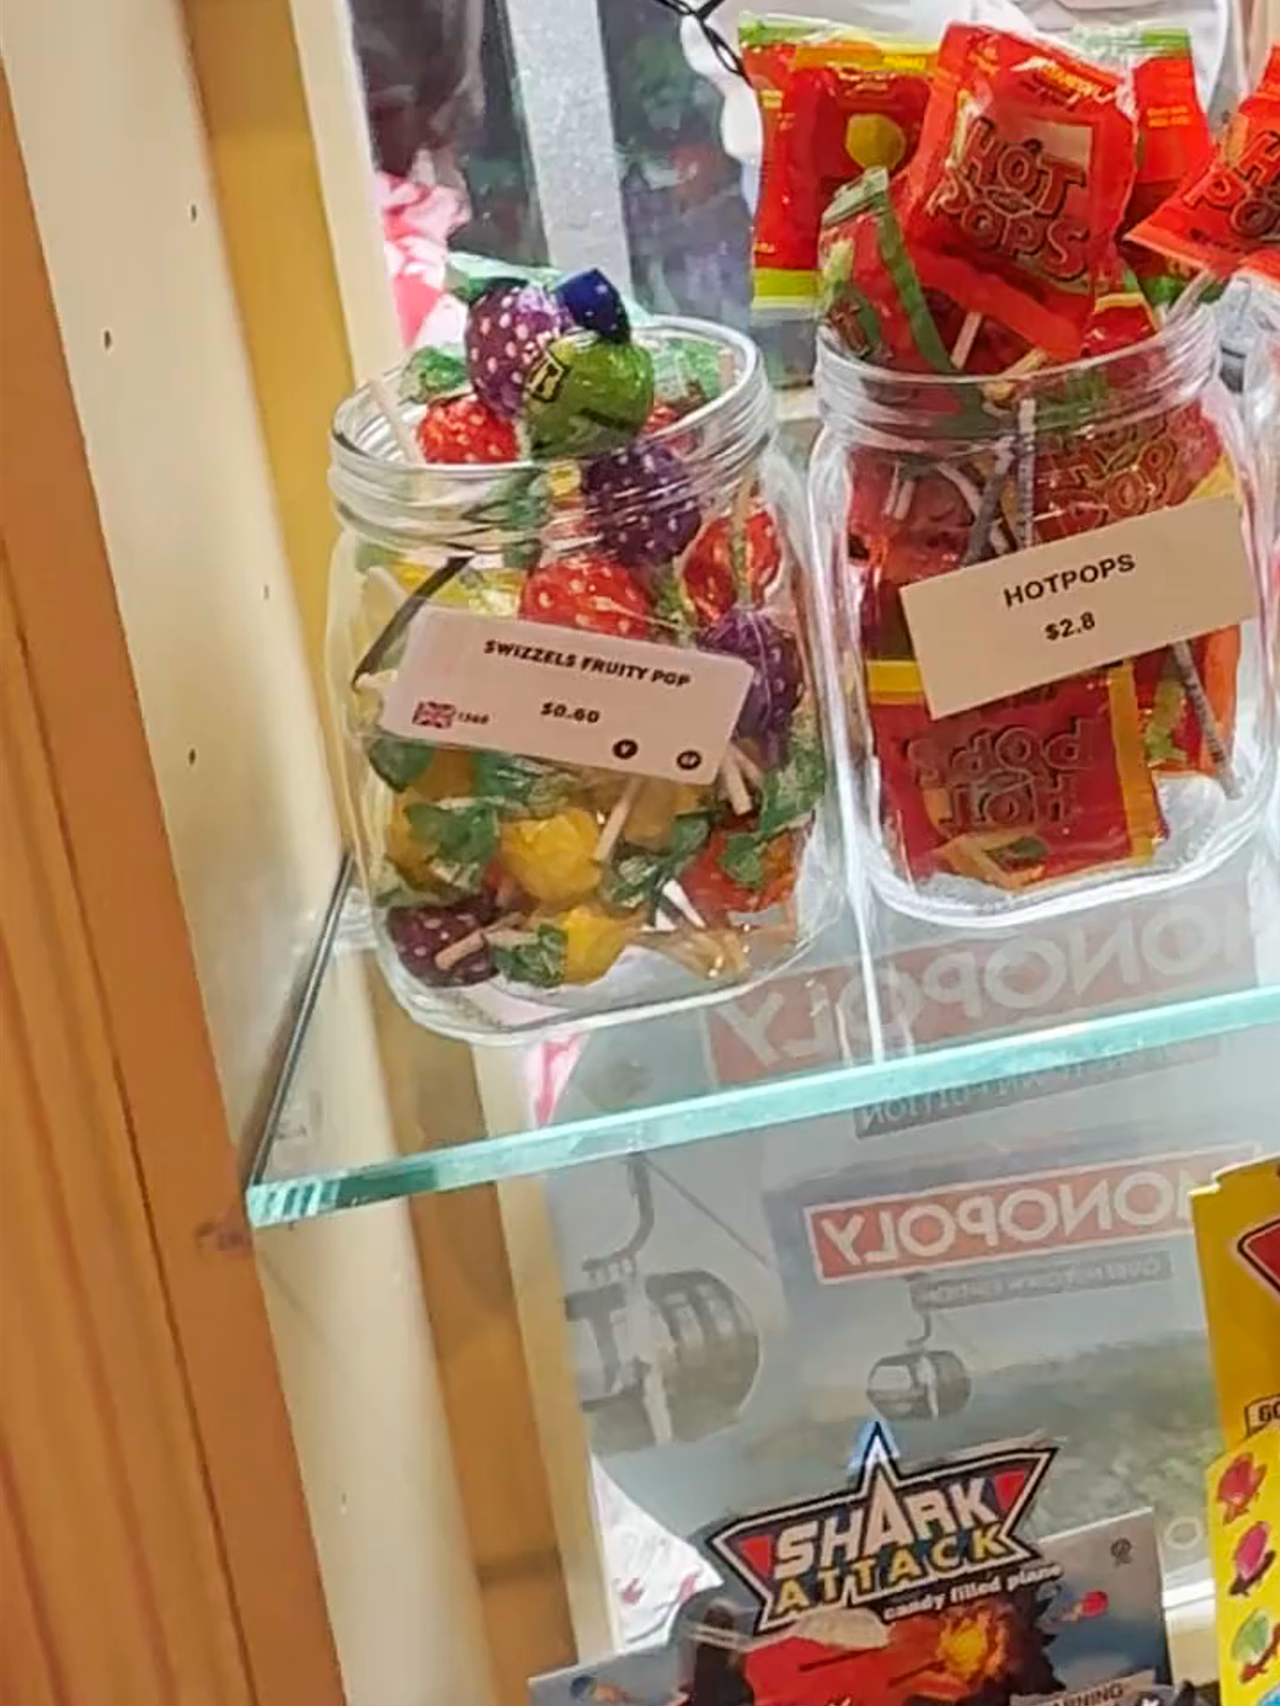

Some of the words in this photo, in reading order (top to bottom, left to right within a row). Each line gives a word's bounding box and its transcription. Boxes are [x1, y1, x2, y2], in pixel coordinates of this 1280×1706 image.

[962, 117, 1085, 215] HOT
[936, 180, 1090, 279] POPS
[1004, 553, 1137, 608] HOTPOPS
[1045, 611, 1097, 642] $2.8
[484, 640, 578, 669] SWIZZELS
[581, 656, 649, 682] FRUITY
[652, 670, 692, 688] POP
[541, 702, 601, 724] $0.60
[776, 1459, 996, 1579] SHARK
[773, 1528, 1007, 1617] ATTACK
[950, 1576, 1000, 1607] filled
[1007, 1563, 1064, 1593] plane
